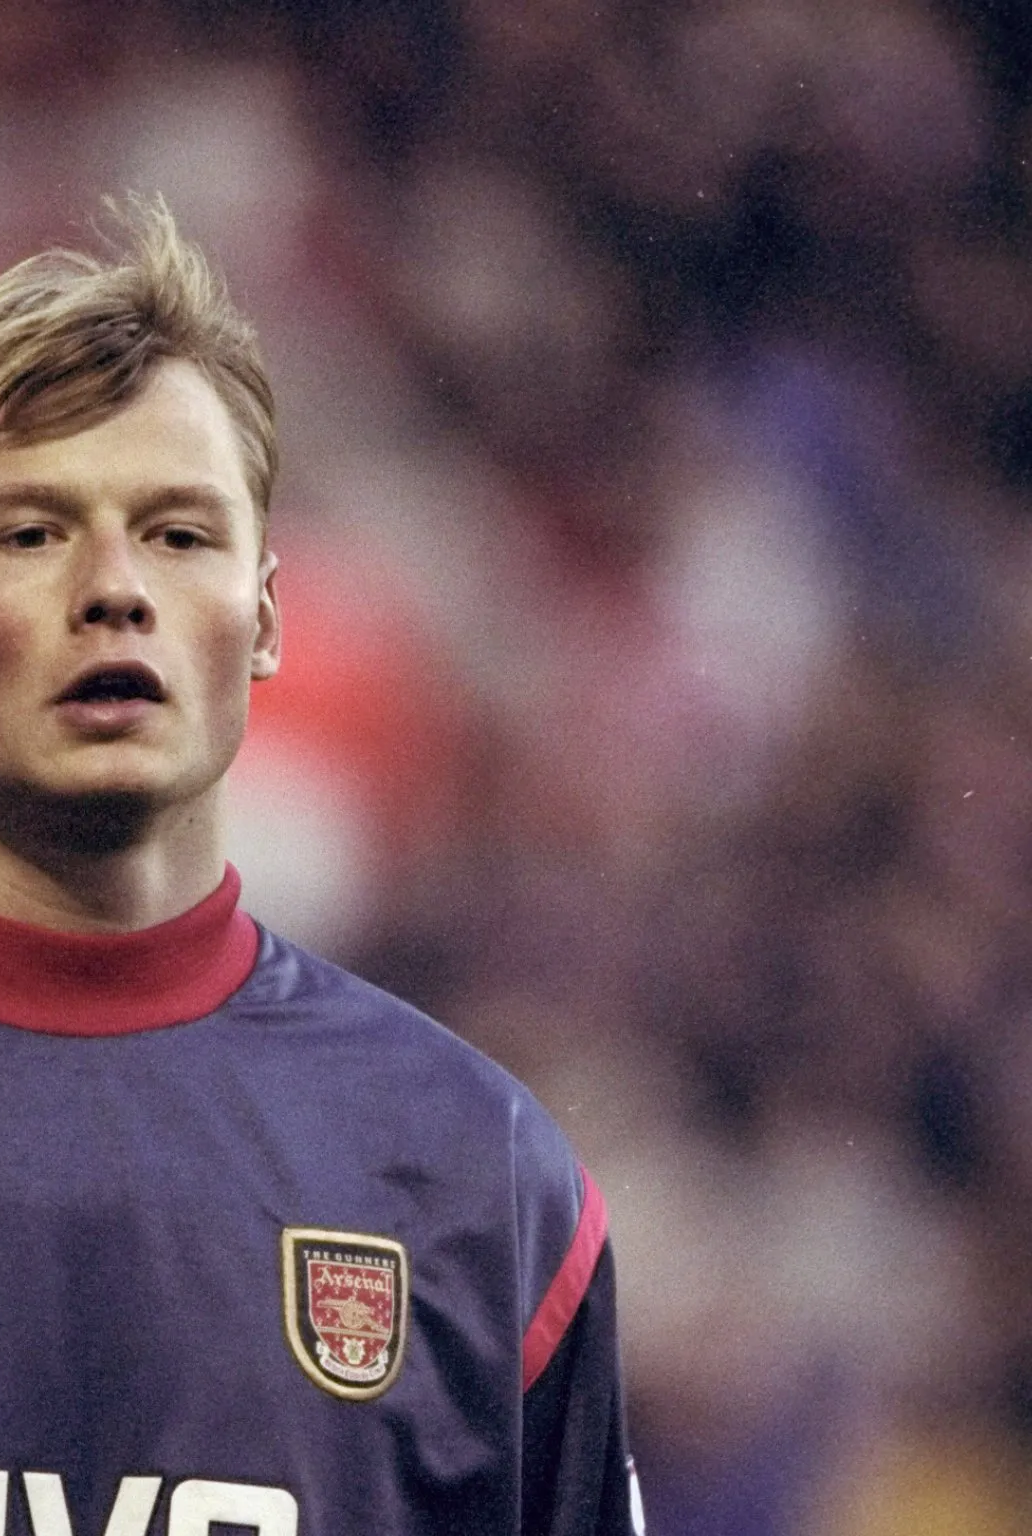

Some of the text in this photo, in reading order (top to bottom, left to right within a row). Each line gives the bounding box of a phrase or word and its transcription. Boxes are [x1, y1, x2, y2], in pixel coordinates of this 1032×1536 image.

[303, 1250, 396, 1268] THE GUNNERS
[318, 1266, 391, 1292] Arsenal
